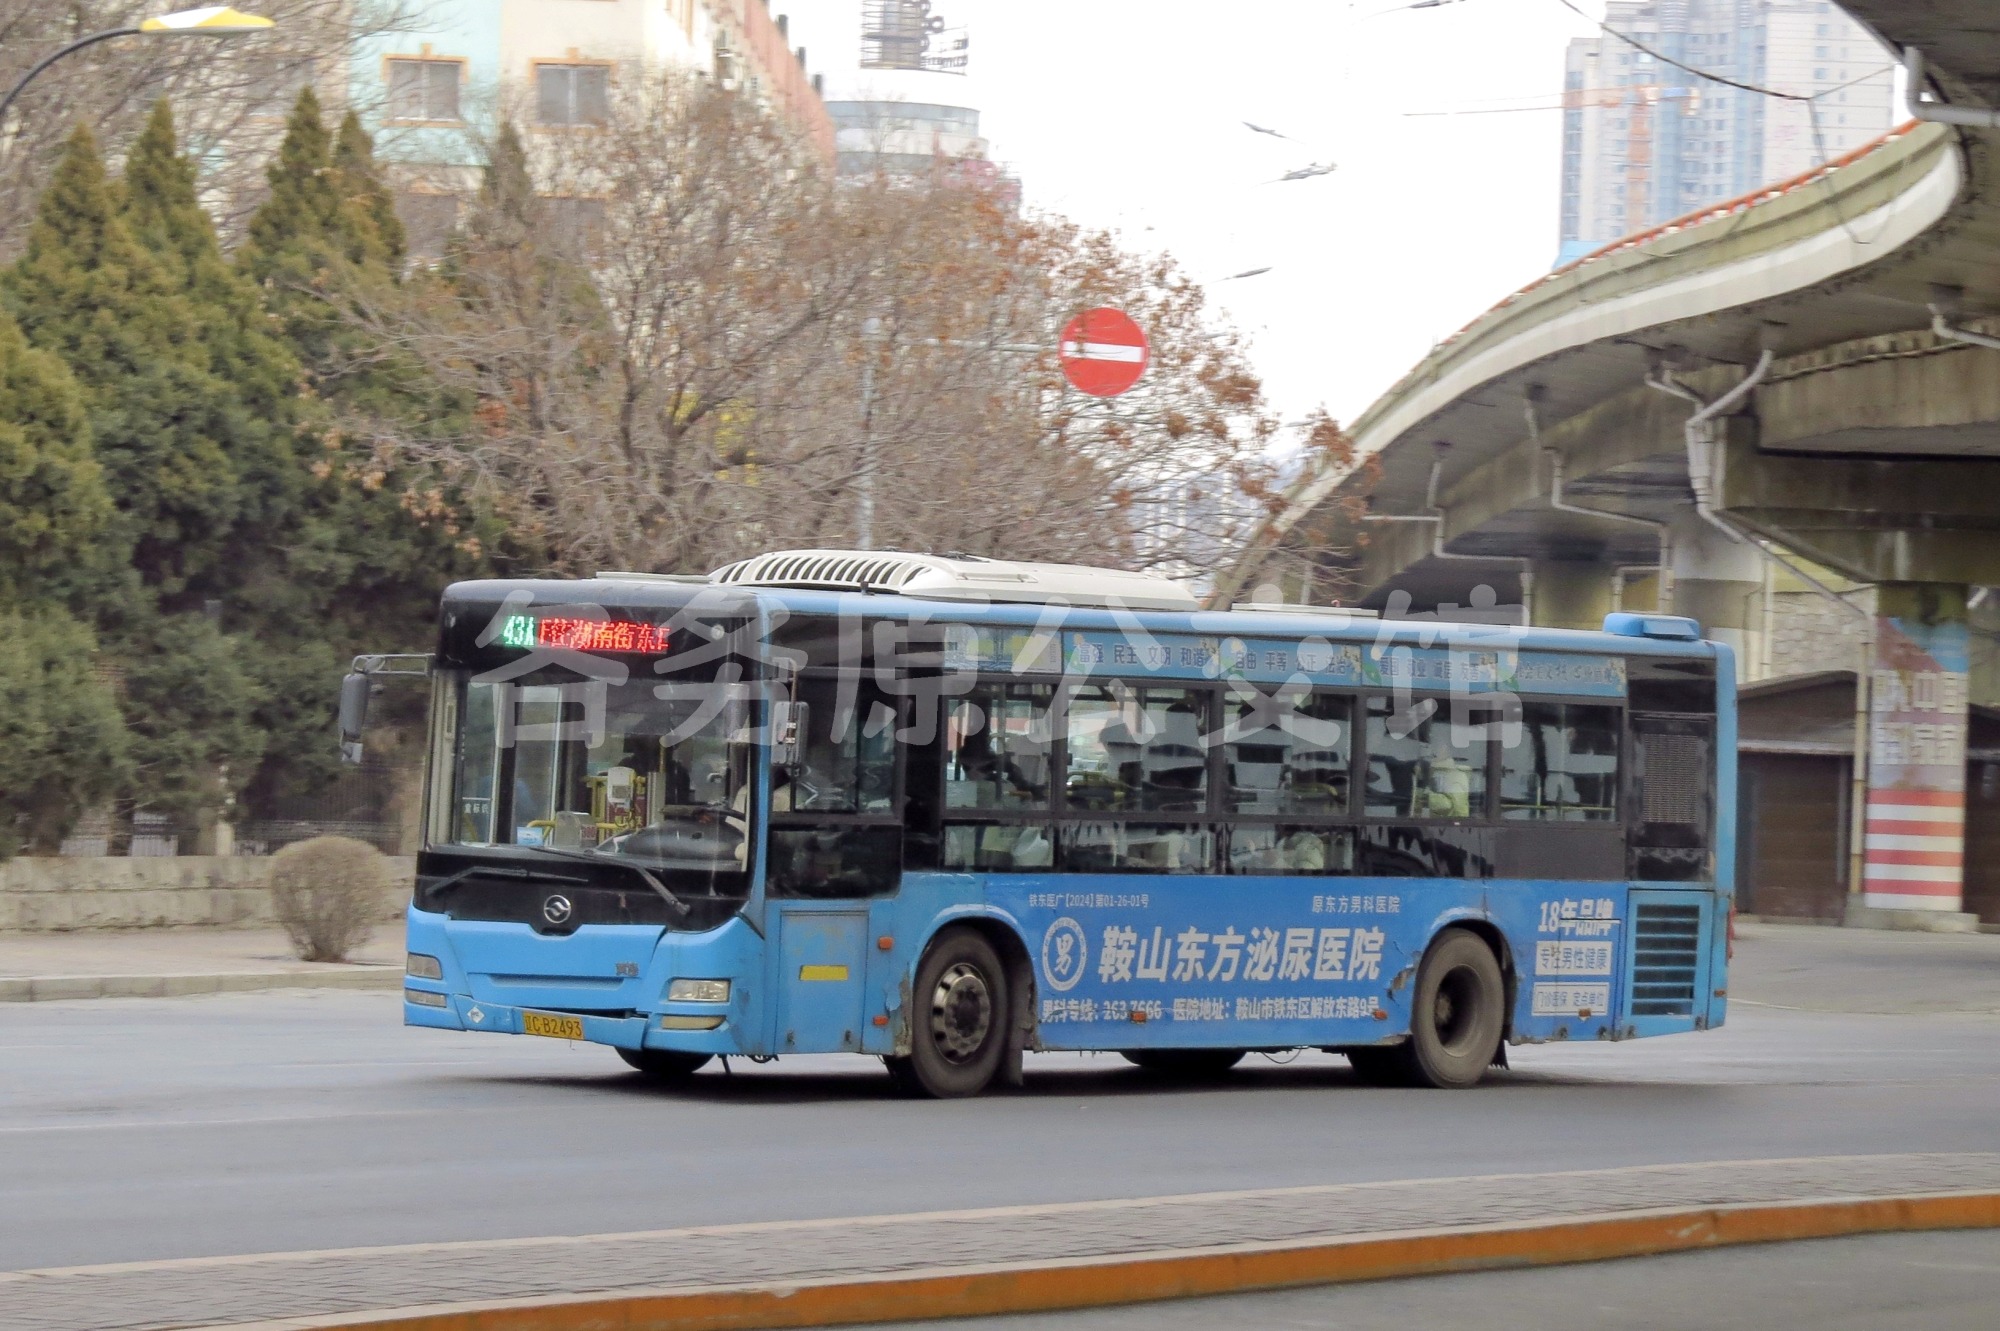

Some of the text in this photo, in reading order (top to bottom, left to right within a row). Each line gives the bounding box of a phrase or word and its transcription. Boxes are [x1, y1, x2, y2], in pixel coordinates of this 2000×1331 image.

[1079, 643, 1104, 663] 富强
[1114, 644, 1137, 664] 民主
[1148, 646, 1171, 665] 文明
[1181, 647, 1206, 667] 和谐
[1265, 652, 1287, 672] 平等
[1311, 895, 1400, 913] 原东方男科医院
[1098, 925, 1385, 984] 鞍山东方泌尿医院
